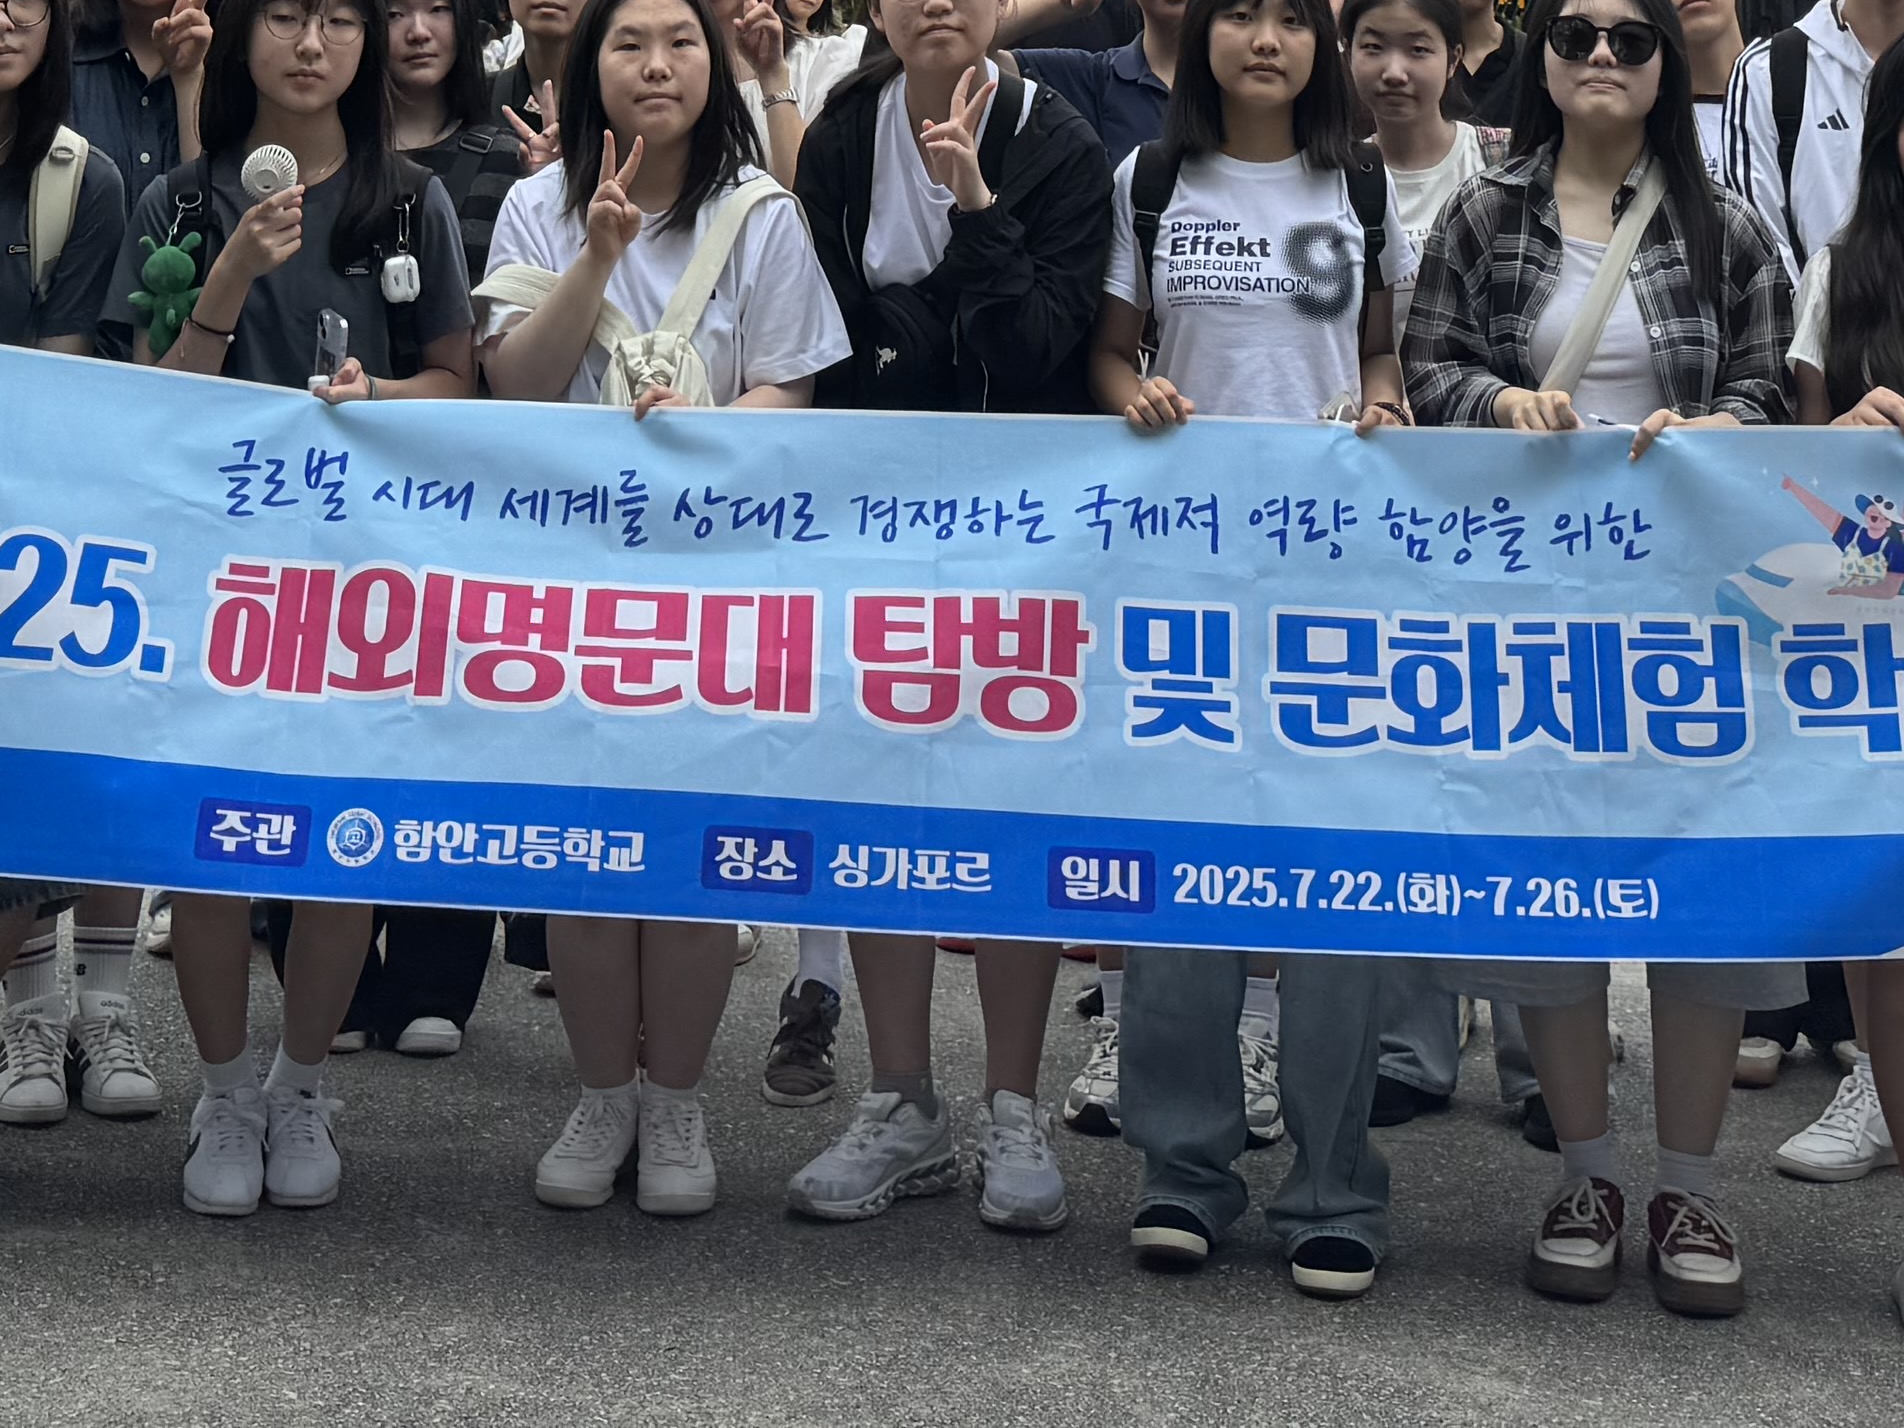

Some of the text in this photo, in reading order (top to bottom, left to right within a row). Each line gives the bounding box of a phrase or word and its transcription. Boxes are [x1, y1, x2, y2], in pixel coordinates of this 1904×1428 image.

[1170, 219, 1241, 233] Doppler
[1169, 236, 1271, 258] Effekt
[1168, 259, 1263, 273] SUBSEQUENT
[1166, 275, 1310, 294] IMPROVISATION
[217, 439, 1654, 574] 글로벌 시대 세계를 상대로 경쟁하는 국제적 역량 함양을 위한
[207, 563, 815, 714] 해외명문대
[852, 594, 1090, 733] 탐방
[1122, 605, 1236, 746] 및
[1269, 611, 1746, 756] 문화체험
[208, 808, 1660, 920] 주관 함안고등학교 장소 싱가포르 일시 2025.7.22.(화)~7.26.(토)
